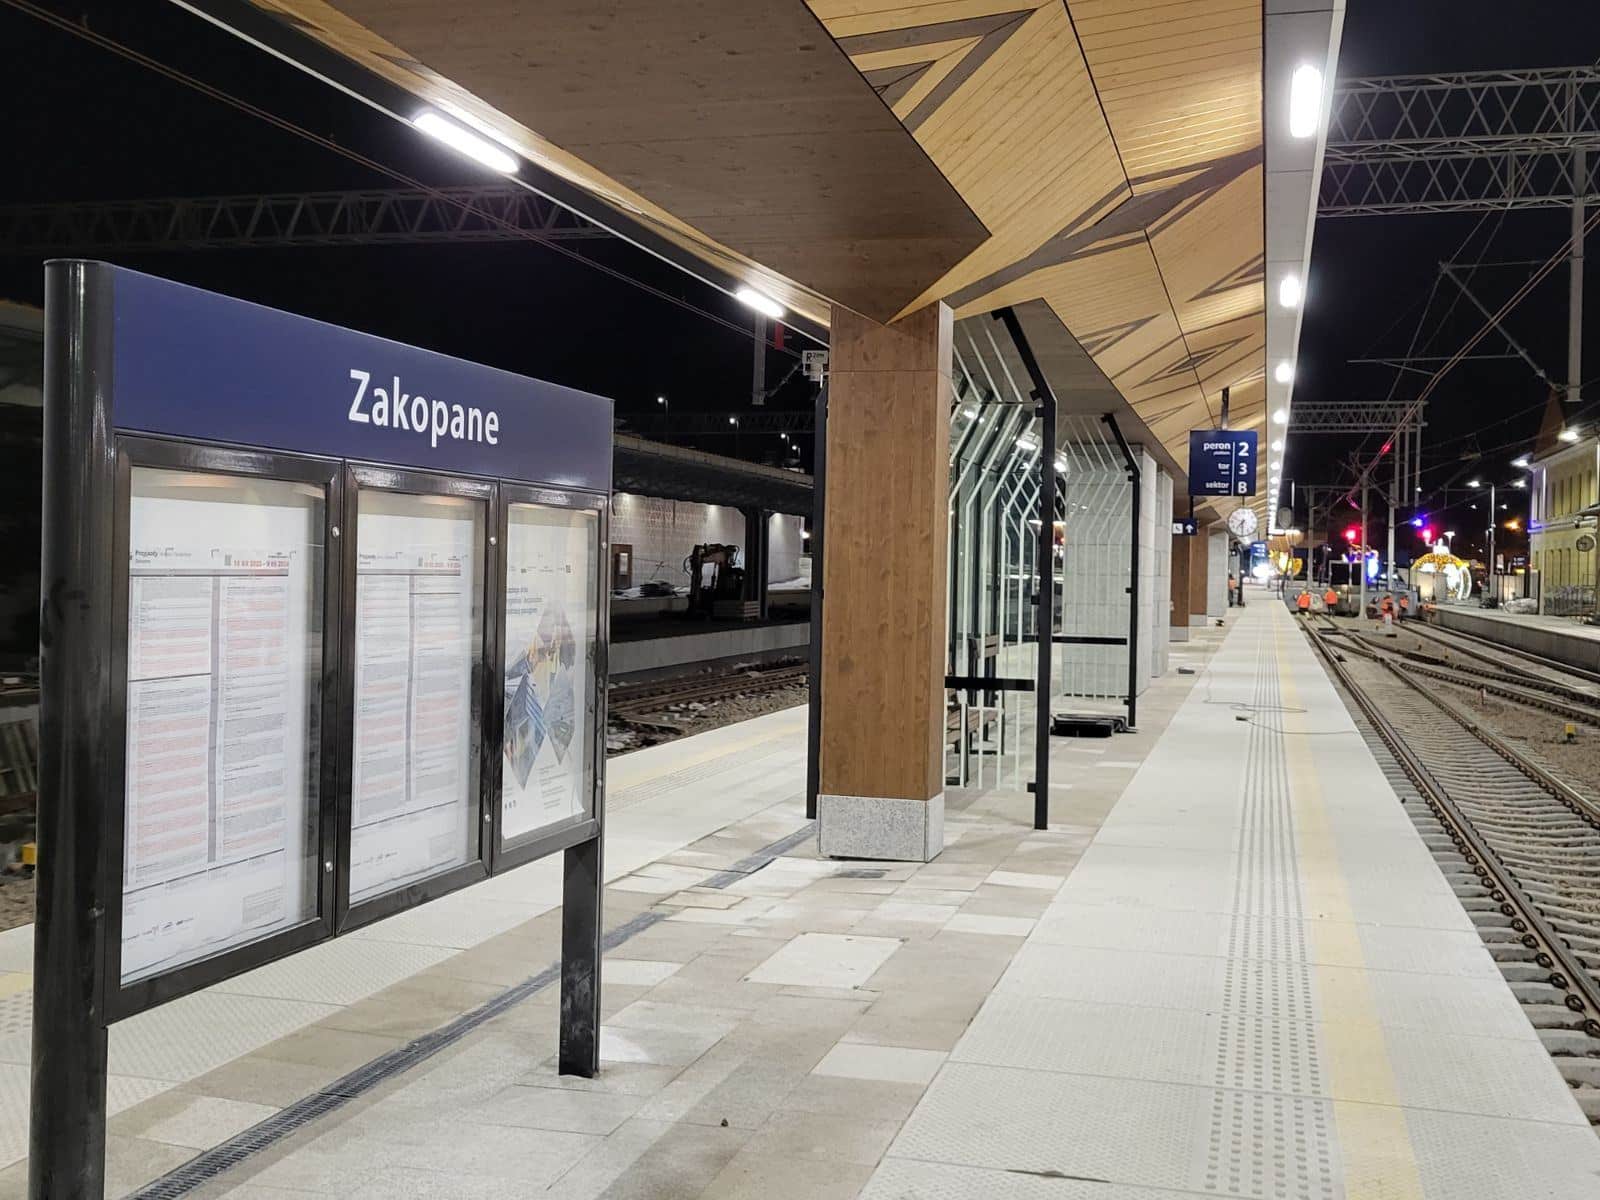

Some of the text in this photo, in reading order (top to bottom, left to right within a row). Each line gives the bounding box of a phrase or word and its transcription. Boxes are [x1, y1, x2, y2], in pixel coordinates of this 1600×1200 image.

[349, 368, 500, 449] Zakopane
[1203, 441, 1249, 457] peron 2
[1218, 462, 1248, 475] tor 3
[1206, 480, 1248, 494] sektor B
